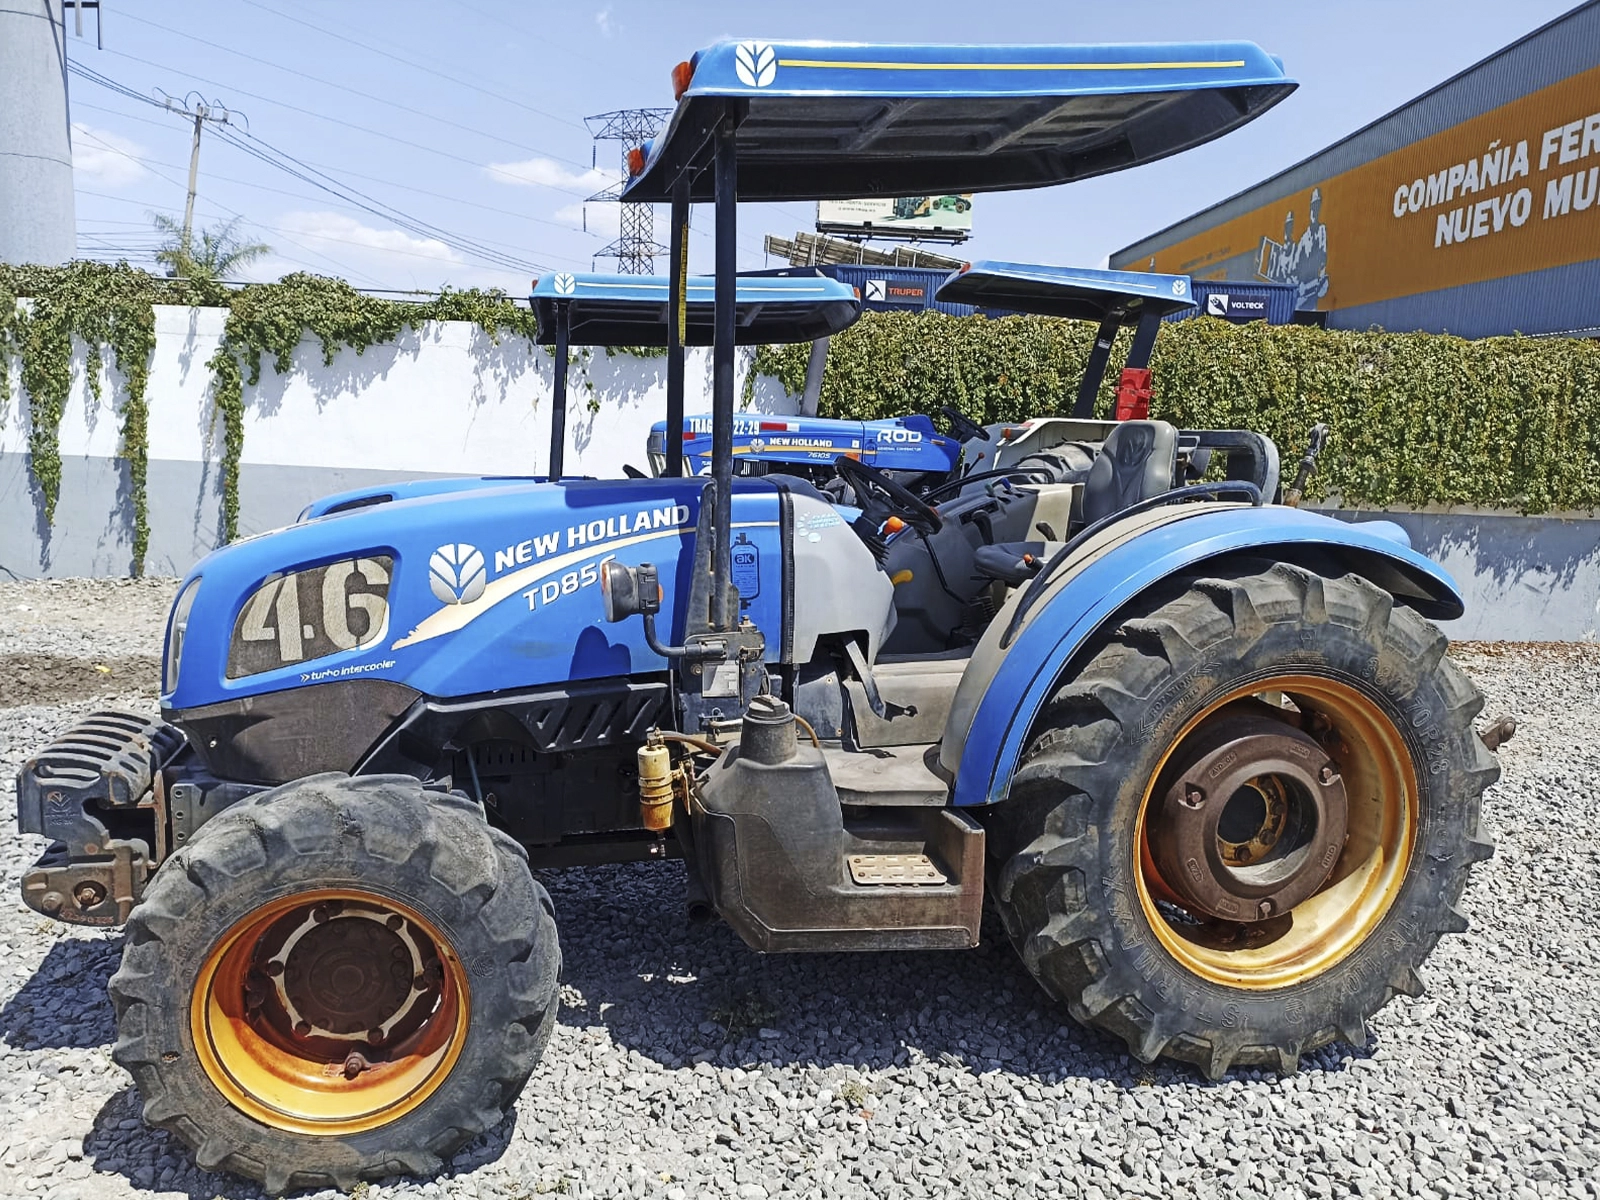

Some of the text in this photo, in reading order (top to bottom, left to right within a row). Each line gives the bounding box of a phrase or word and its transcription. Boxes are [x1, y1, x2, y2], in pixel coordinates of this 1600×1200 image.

[1393, 139, 1529, 218] COMPAÑIA
[1434, 166, 1600, 248] NUEVO MU
[888, 287, 924, 297] TRUPER
[769, 437, 833, 448] NEW HOLLAND
[877, 430, 922, 443] ROD
[495, 504, 691, 573] NEW HOLLAND
[523, 553, 616, 611] TD85
[341, 660, 396, 676] intercooler
